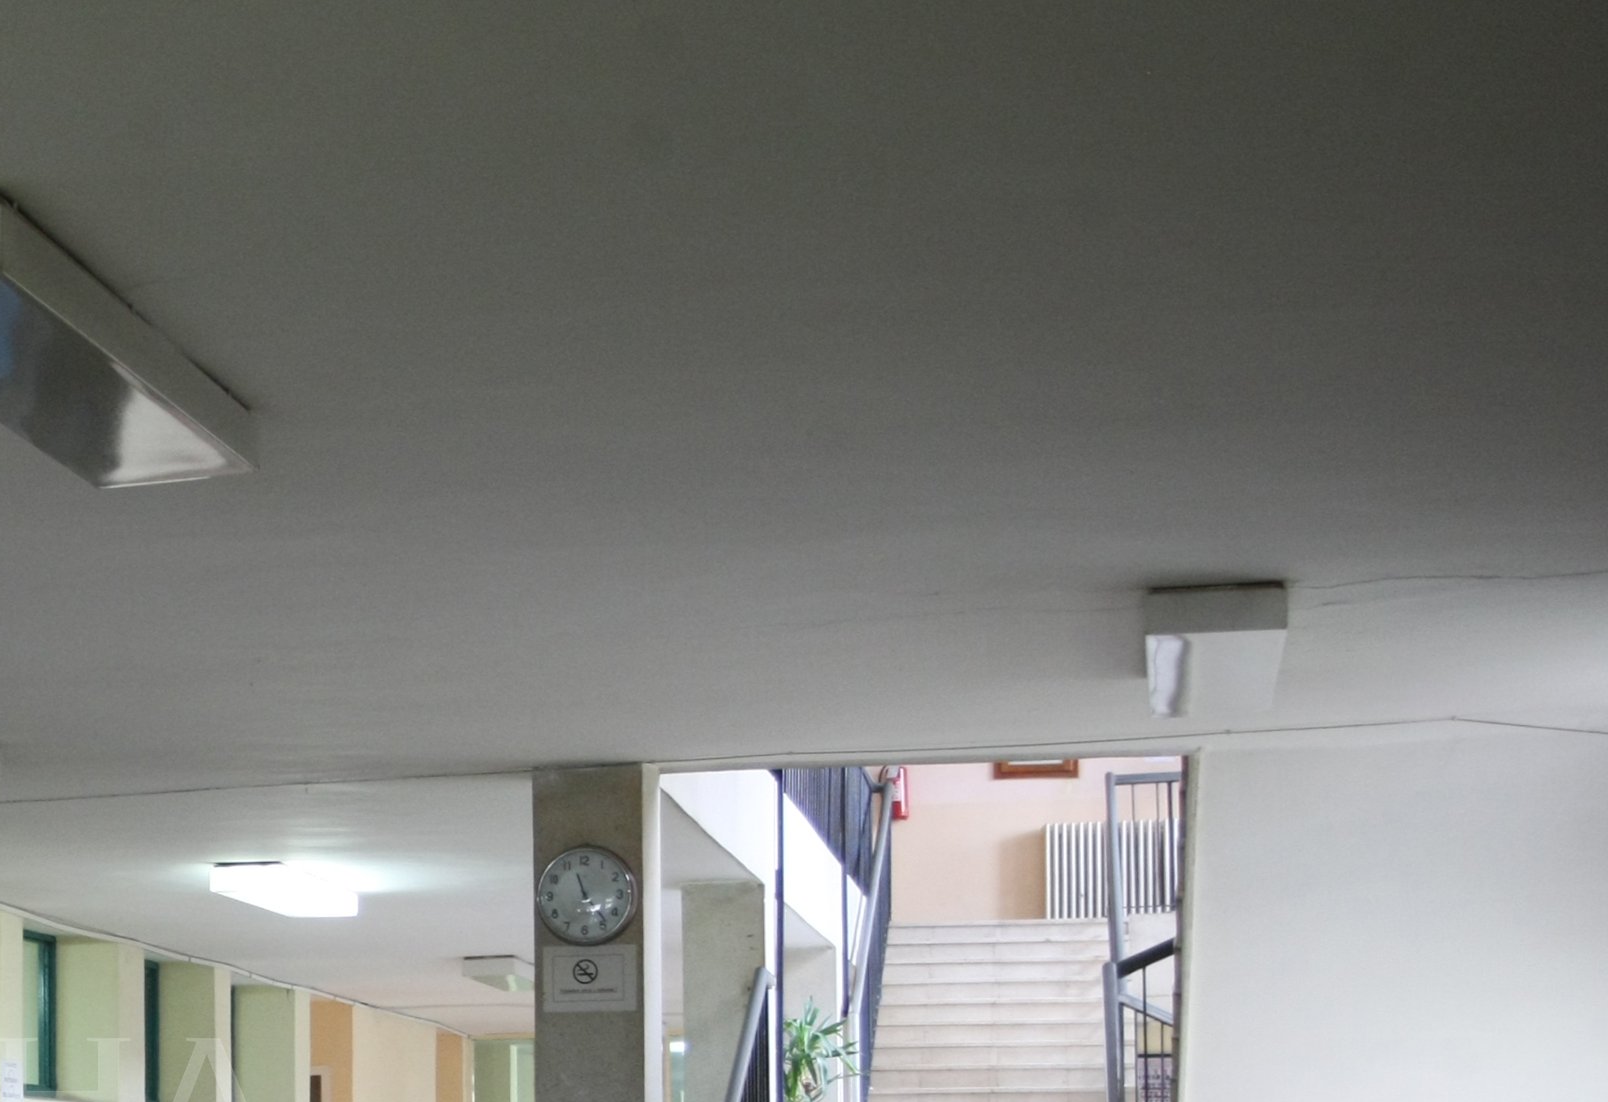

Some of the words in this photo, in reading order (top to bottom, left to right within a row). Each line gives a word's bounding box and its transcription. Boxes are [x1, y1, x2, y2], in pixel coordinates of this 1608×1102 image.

[579, 855, 590, 866] 12
[562, 861, 571, 871] 11
[550, 874, 559, 885] 10
[611, 872, 619, 882] 2
[546, 892, 554, 901] 9
[616, 889, 623, 899] 3
[551, 909, 558, 919] 8
[611, 907, 618, 917] 4
[563, 922, 570, 932] 7
[581, 925, 588, 936] 6
[600, 920, 607, 931] 5
